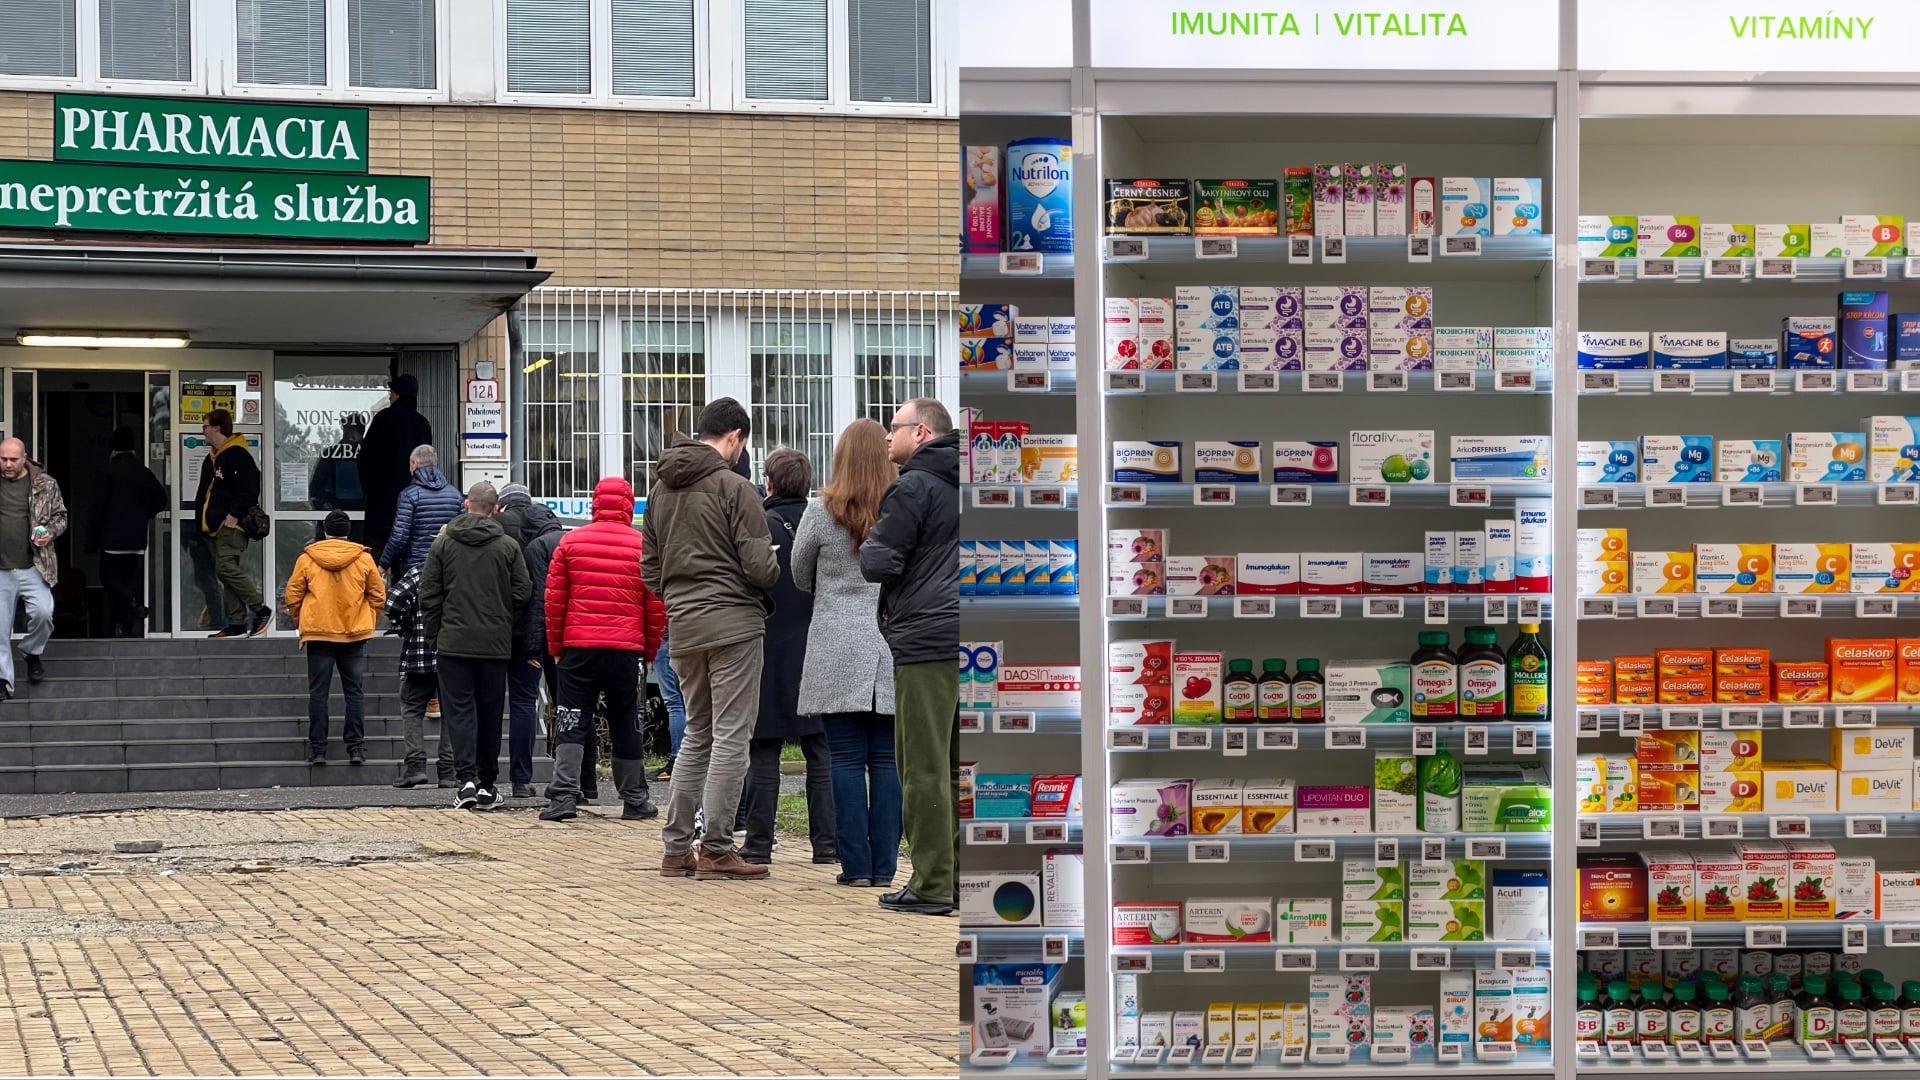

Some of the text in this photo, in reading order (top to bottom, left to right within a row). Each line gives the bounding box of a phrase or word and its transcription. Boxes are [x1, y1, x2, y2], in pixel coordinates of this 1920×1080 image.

[1171, 12, 1468, 36] IMUNITA VITALITA
[1729, 10, 1874, 39] VITAMÍNY
[60, 106, 360, 160] PHARMACIA
[1012, 167, 1069, 180] Nutrilon
[1114, 187, 1180, 197] ČERNÝ ČESNEK
[0, 177, 419, 227] nepretržitá služba
[1613, 230, 1628, 239] B5
[1675, 229, 1687, 237] B6
[1881, 228, 1891, 240] B
[1012, 231, 1023, 250] 2
[1790, 235, 1797, 244] B
[1214, 301, 1230, 309] ATB
[1216, 343, 1232, 351] ATB
[473, 385, 493, 398] 12A
[1352, 432, 1395, 443] floraliv
[1688, 450, 1702, 460] Mg
[1840, 448, 1855, 459] Mg
[1907, 448, 1918, 458] Mg
[1615, 454, 1627, 463] Mg
[1757, 454, 1770, 463] Mg
[1608, 539, 1617, 549] C
[1747, 558, 1758, 572] C
[1826, 558, 1837, 572] C
[1903, 553, 1915, 567] C
[1672, 565, 1682, 578] C
[1609, 572, 1617, 582] C
[1836, 646, 1890, 658] Celaskon
[1663, 654, 1704, 664] Celaskon
[1719, 653, 1761, 663] Celaskon
[1618, 662, 1651, 670] Celaskon
[1780, 669, 1824, 679] Celaskon
[1417, 679, 1452, 688] Omega-3
[1468, 680, 1496, 689] Omega
[1663, 681, 1703, 690] Celaskon
[1719, 680, 1761, 689] Celaskon
[1739, 743, 1750, 754] D
[1875, 739, 1903, 749] DeVit
[977, 783, 1013, 791] Imodium
[1038, 783, 1068, 792] Rennie
[1597, 785, 1603, 794] D
[1628, 784, 1635, 792] D
[1738, 784, 1749, 795] D
[1797, 783, 1825, 793] DeVit
[1873, 780, 1901, 789] DeVit
[1047, 863, 1055, 902] REVALID
[1883, 878, 1915, 887] Detrical
[1497, 889, 1522, 897] Acutil
[1116, 913, 1157, 921] ARTERIN
[1602, 961, 1612, 974] C
[1639, 962, 1650, 973] C
[1680, 961, 1690, 972] C
[1717, 961, 1727, 973] C
[1617, 1022, 1625, 1031] B
[1648, 1020, 1656, 1030] B
[1681, 1021, 1690, 1032] C
[1715, 1022, 1724, 1032] C
